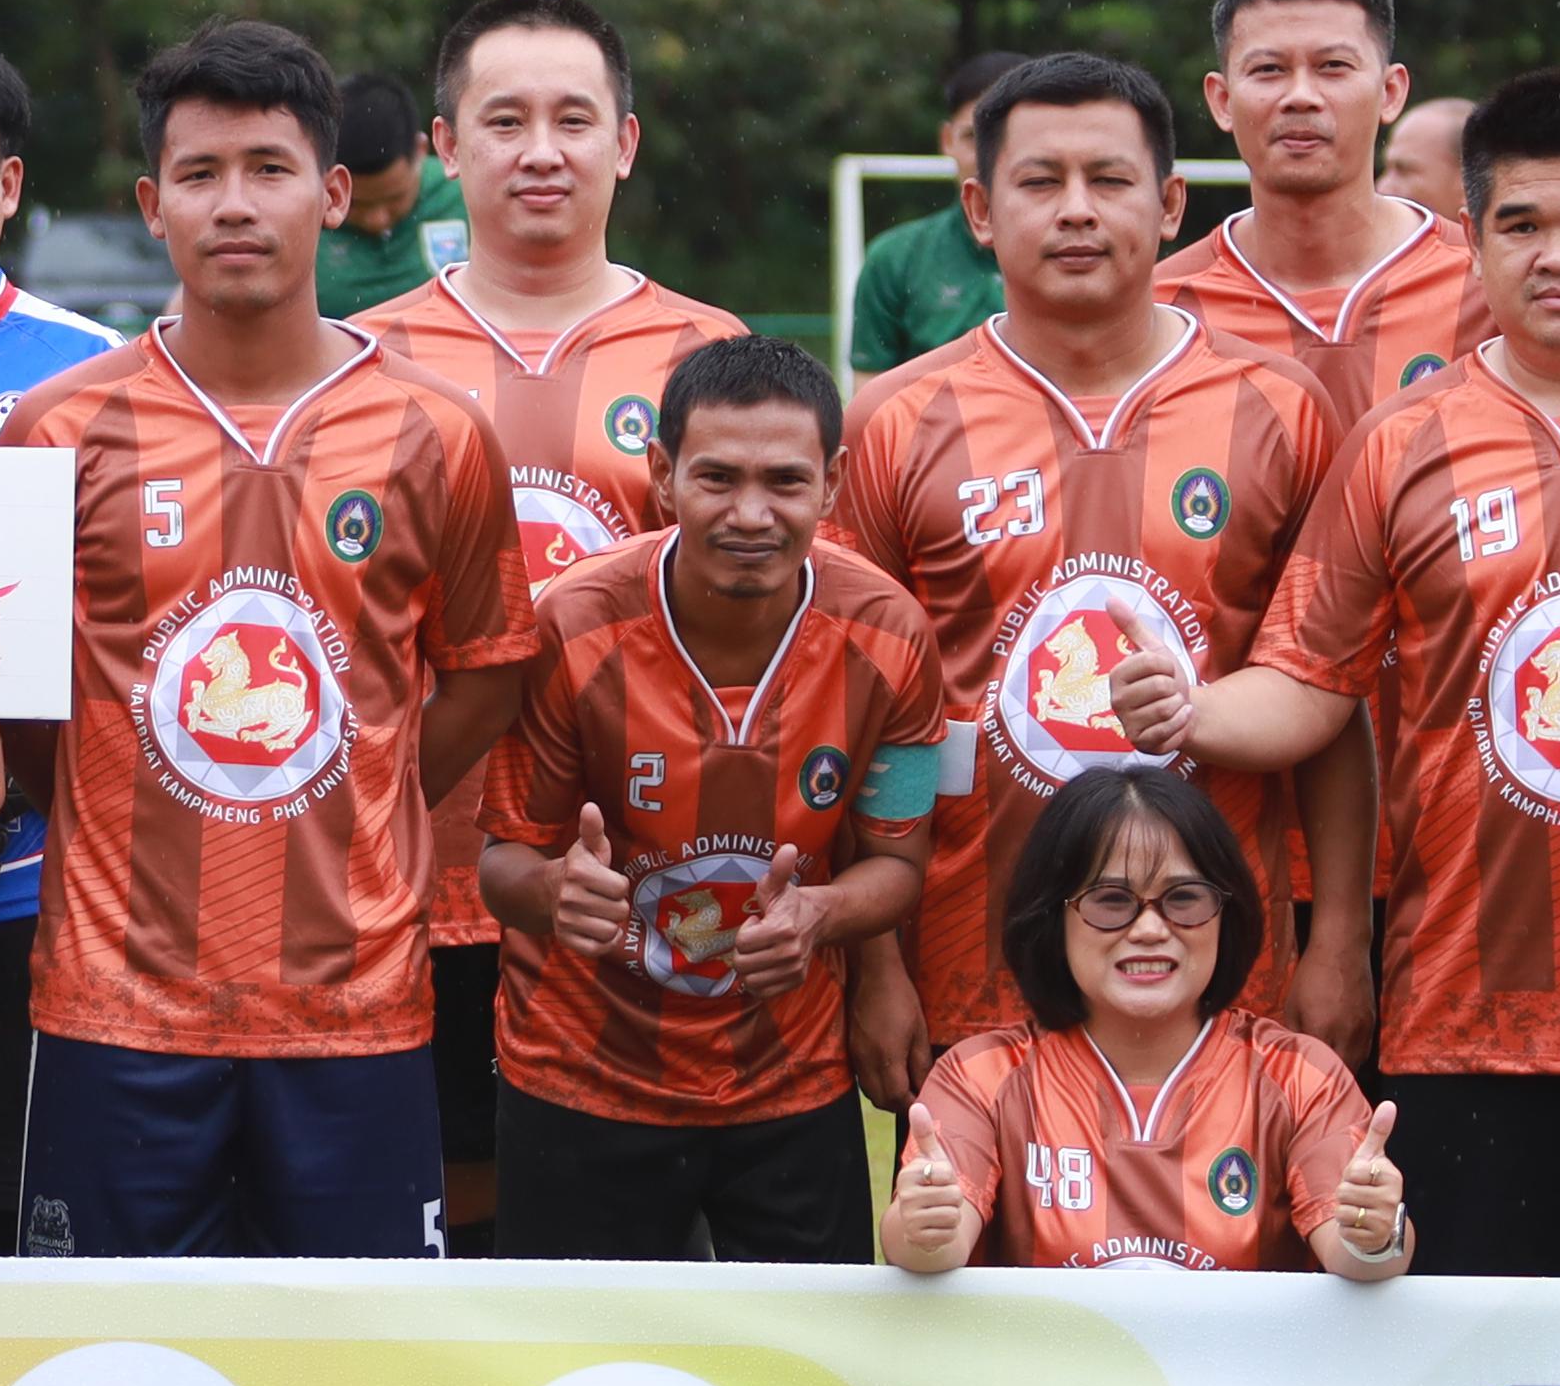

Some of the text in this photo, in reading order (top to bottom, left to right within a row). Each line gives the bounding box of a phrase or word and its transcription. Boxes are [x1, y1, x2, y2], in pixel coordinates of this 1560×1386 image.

[144, 479, 184, 547] 5
[957, 468, 1046, 546] 23
[1450, 485, 1519, 562] 19
[142, 590, 203, 662] PUBLIC
[993, 552, 1207, 656] PUBLIC ADMINISTRATION
[159, 771, 261, 824] KAMPHAENG
[273, 792, 309, 821] PHET
[629, 752, 666, 812] 2
[625, 849, 675, 881] PUBLIC
[1025, 1142, 1093, 1211] 48
